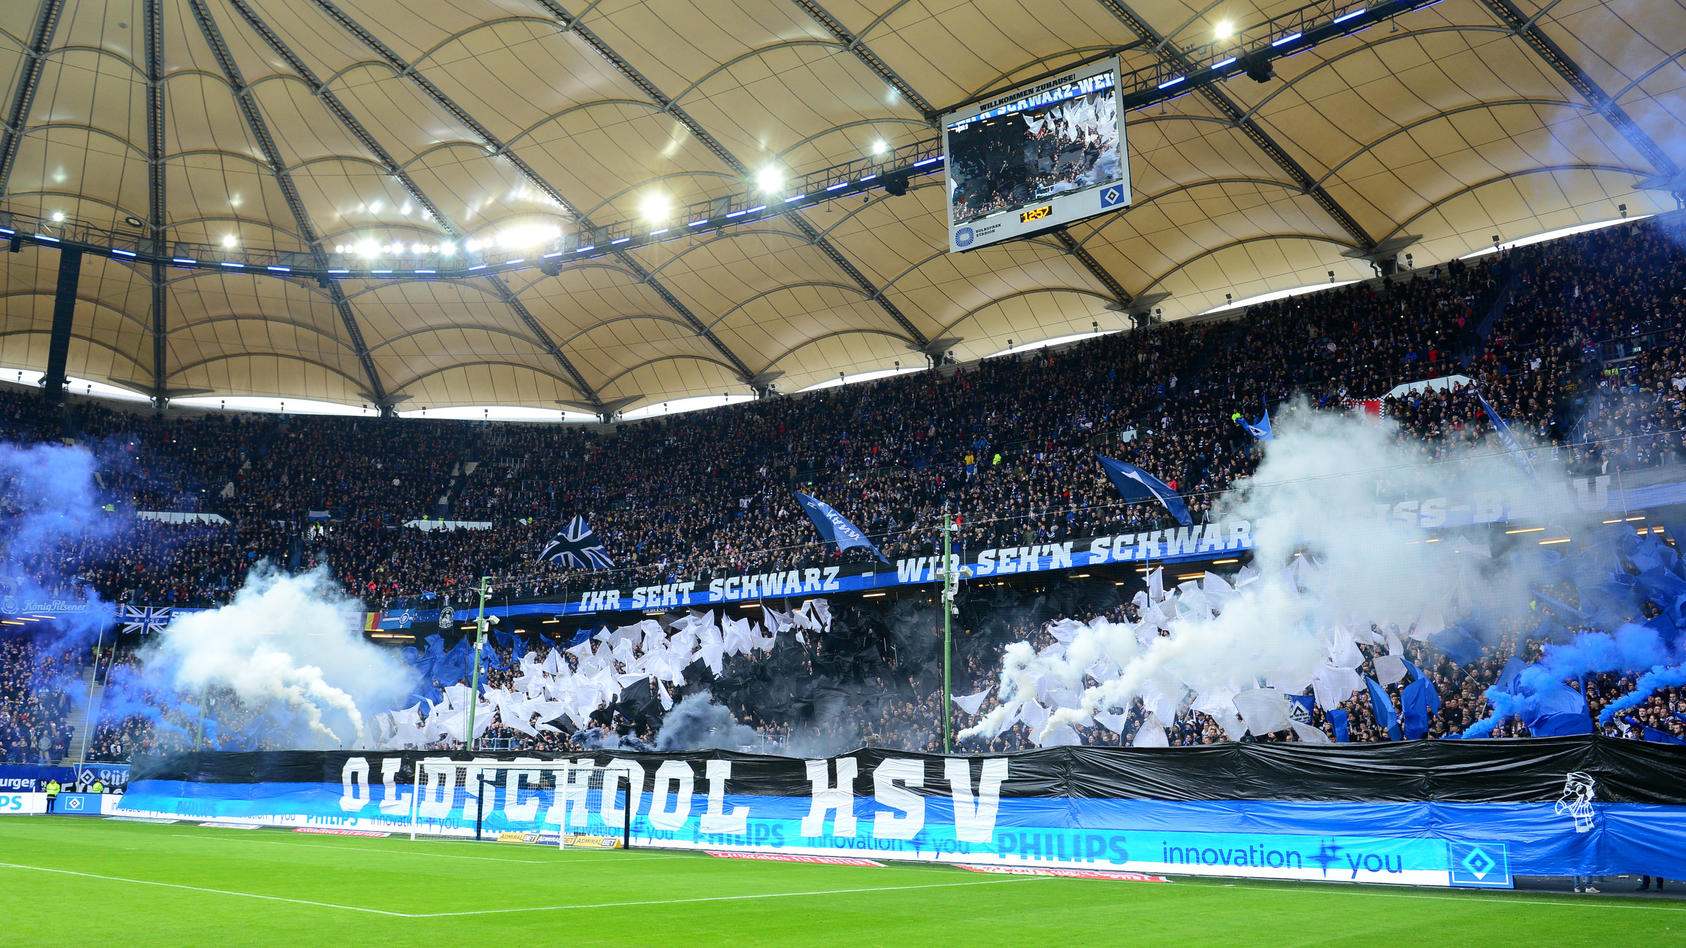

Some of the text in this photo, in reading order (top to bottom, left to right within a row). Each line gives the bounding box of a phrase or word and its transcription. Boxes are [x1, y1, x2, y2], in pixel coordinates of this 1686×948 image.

[979, 73, 1076, 111] WILLKOMMEN ZUHAUSE!
[579, 590, 620, 612] IHR
[632, 581, 695, 609] SEHT
[709, 566, 840, 602] SCHWARZ
[897, 553, 960, 583] WIR
[976, 541, 1074, 576] SEH'N
[339, 757, 1009, 843] OLDSCHOOL HSV
[999, 832, 1129, 864] PHILIPS
[1163, 840, 1403, 879] innovation you
